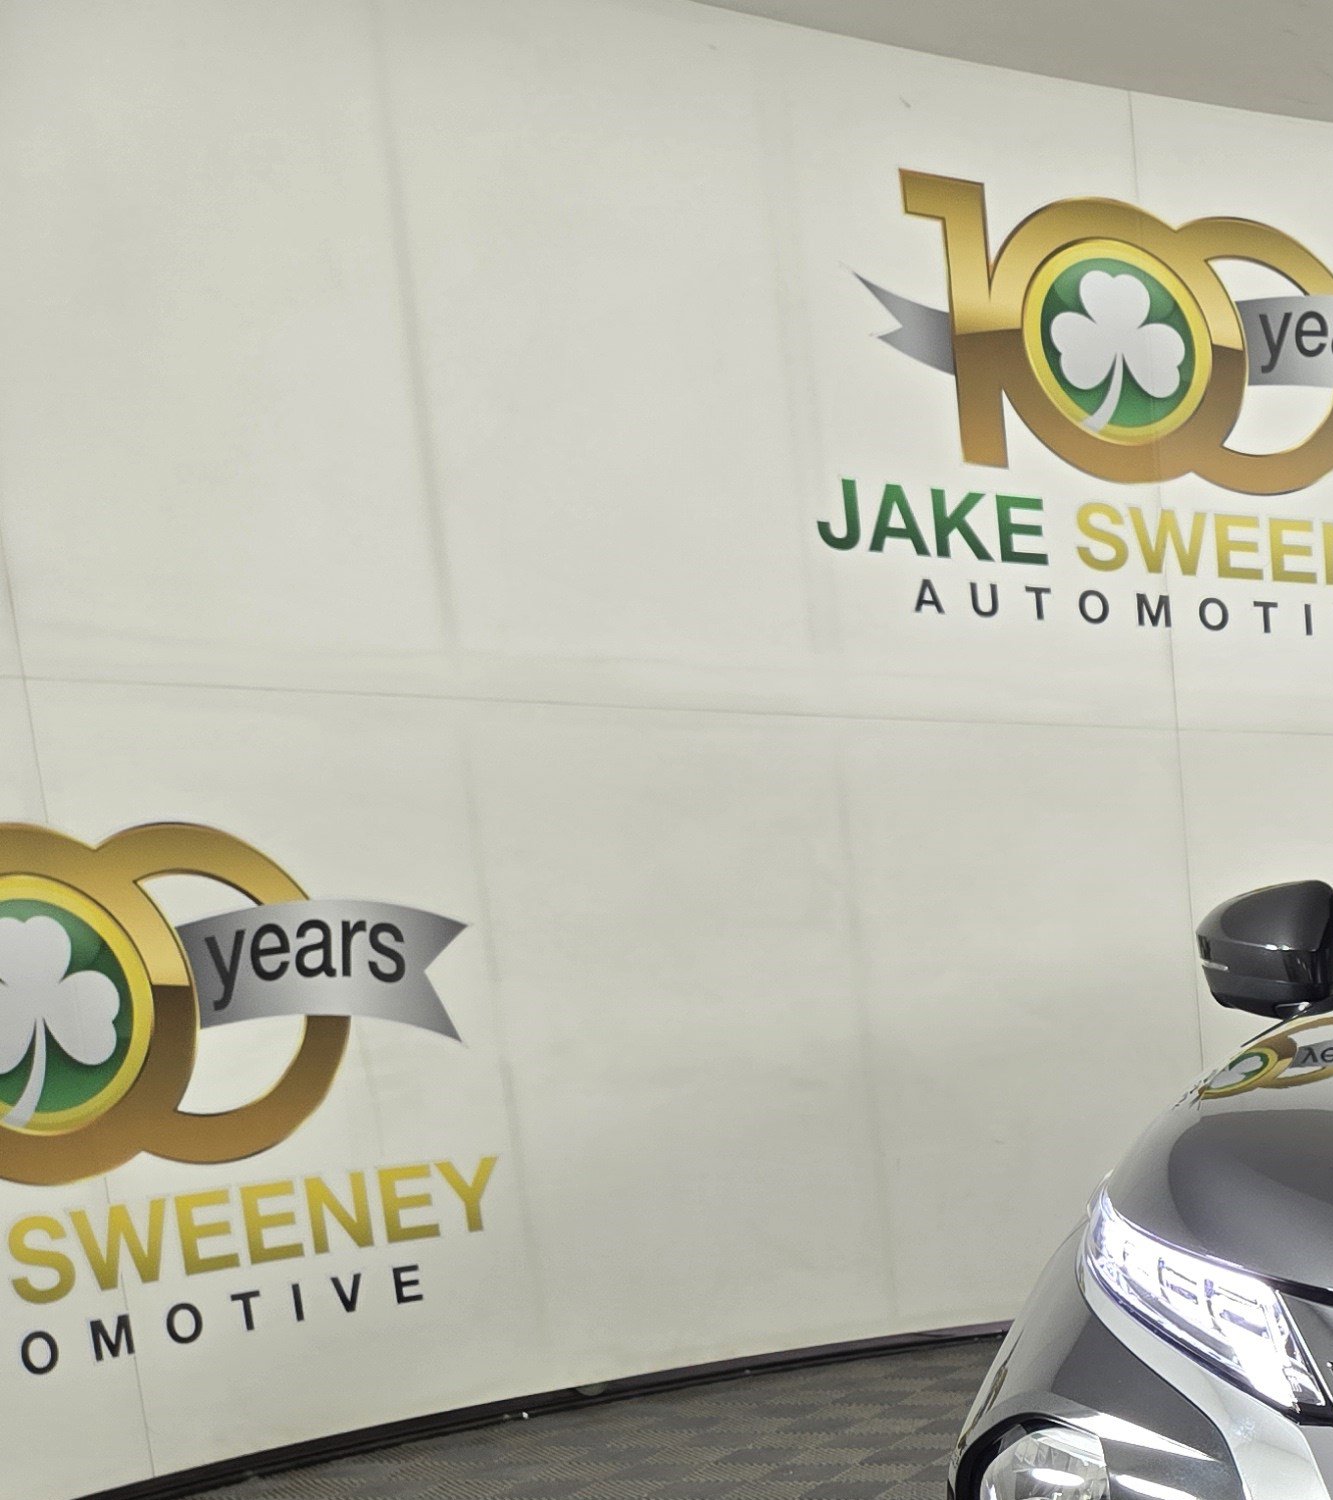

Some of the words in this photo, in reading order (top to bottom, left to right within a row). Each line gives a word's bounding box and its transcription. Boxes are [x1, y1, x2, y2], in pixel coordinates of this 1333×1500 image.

[817, 479, 1048, 566] JAKE
[0, 822, 352, 1186] 00
[205, 919, 406, 1012] years
[8, 1156, 499, 1304] SWEENEY
[20, 1265, 425, 1376] OMOTIVE
